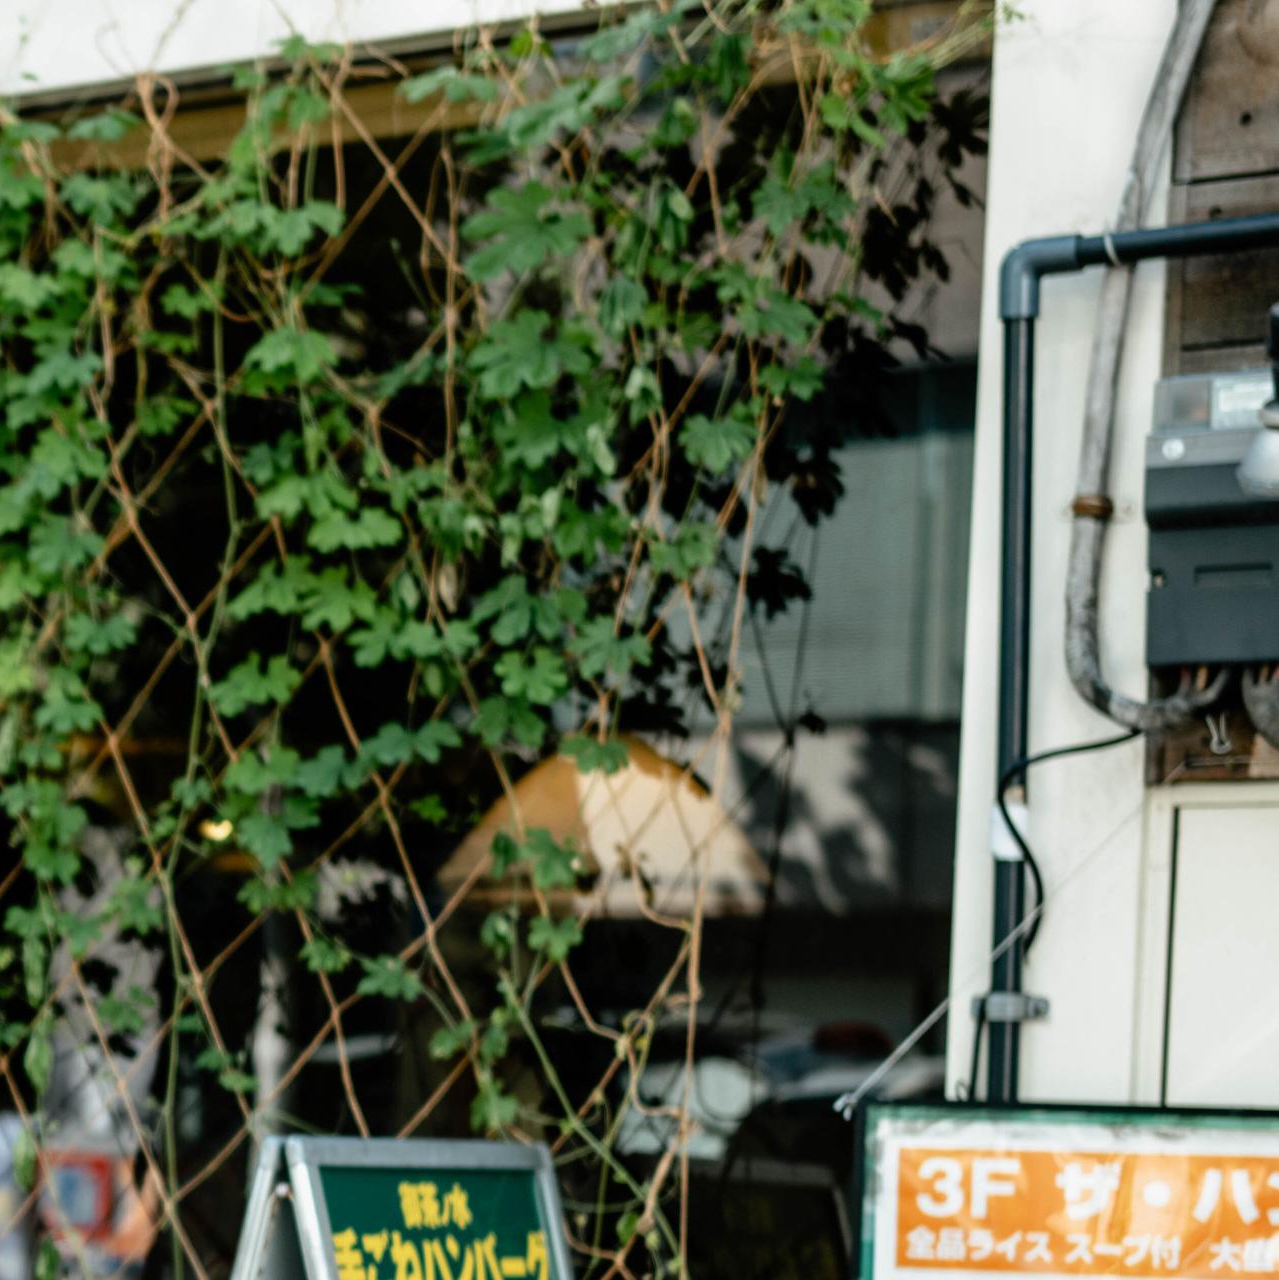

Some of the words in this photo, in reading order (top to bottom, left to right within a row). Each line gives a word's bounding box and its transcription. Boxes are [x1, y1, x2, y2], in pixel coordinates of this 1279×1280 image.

[915, 1158, 1020, 1220] 3F
[1055, 1162, 1279, 1226] ザ・ハ
